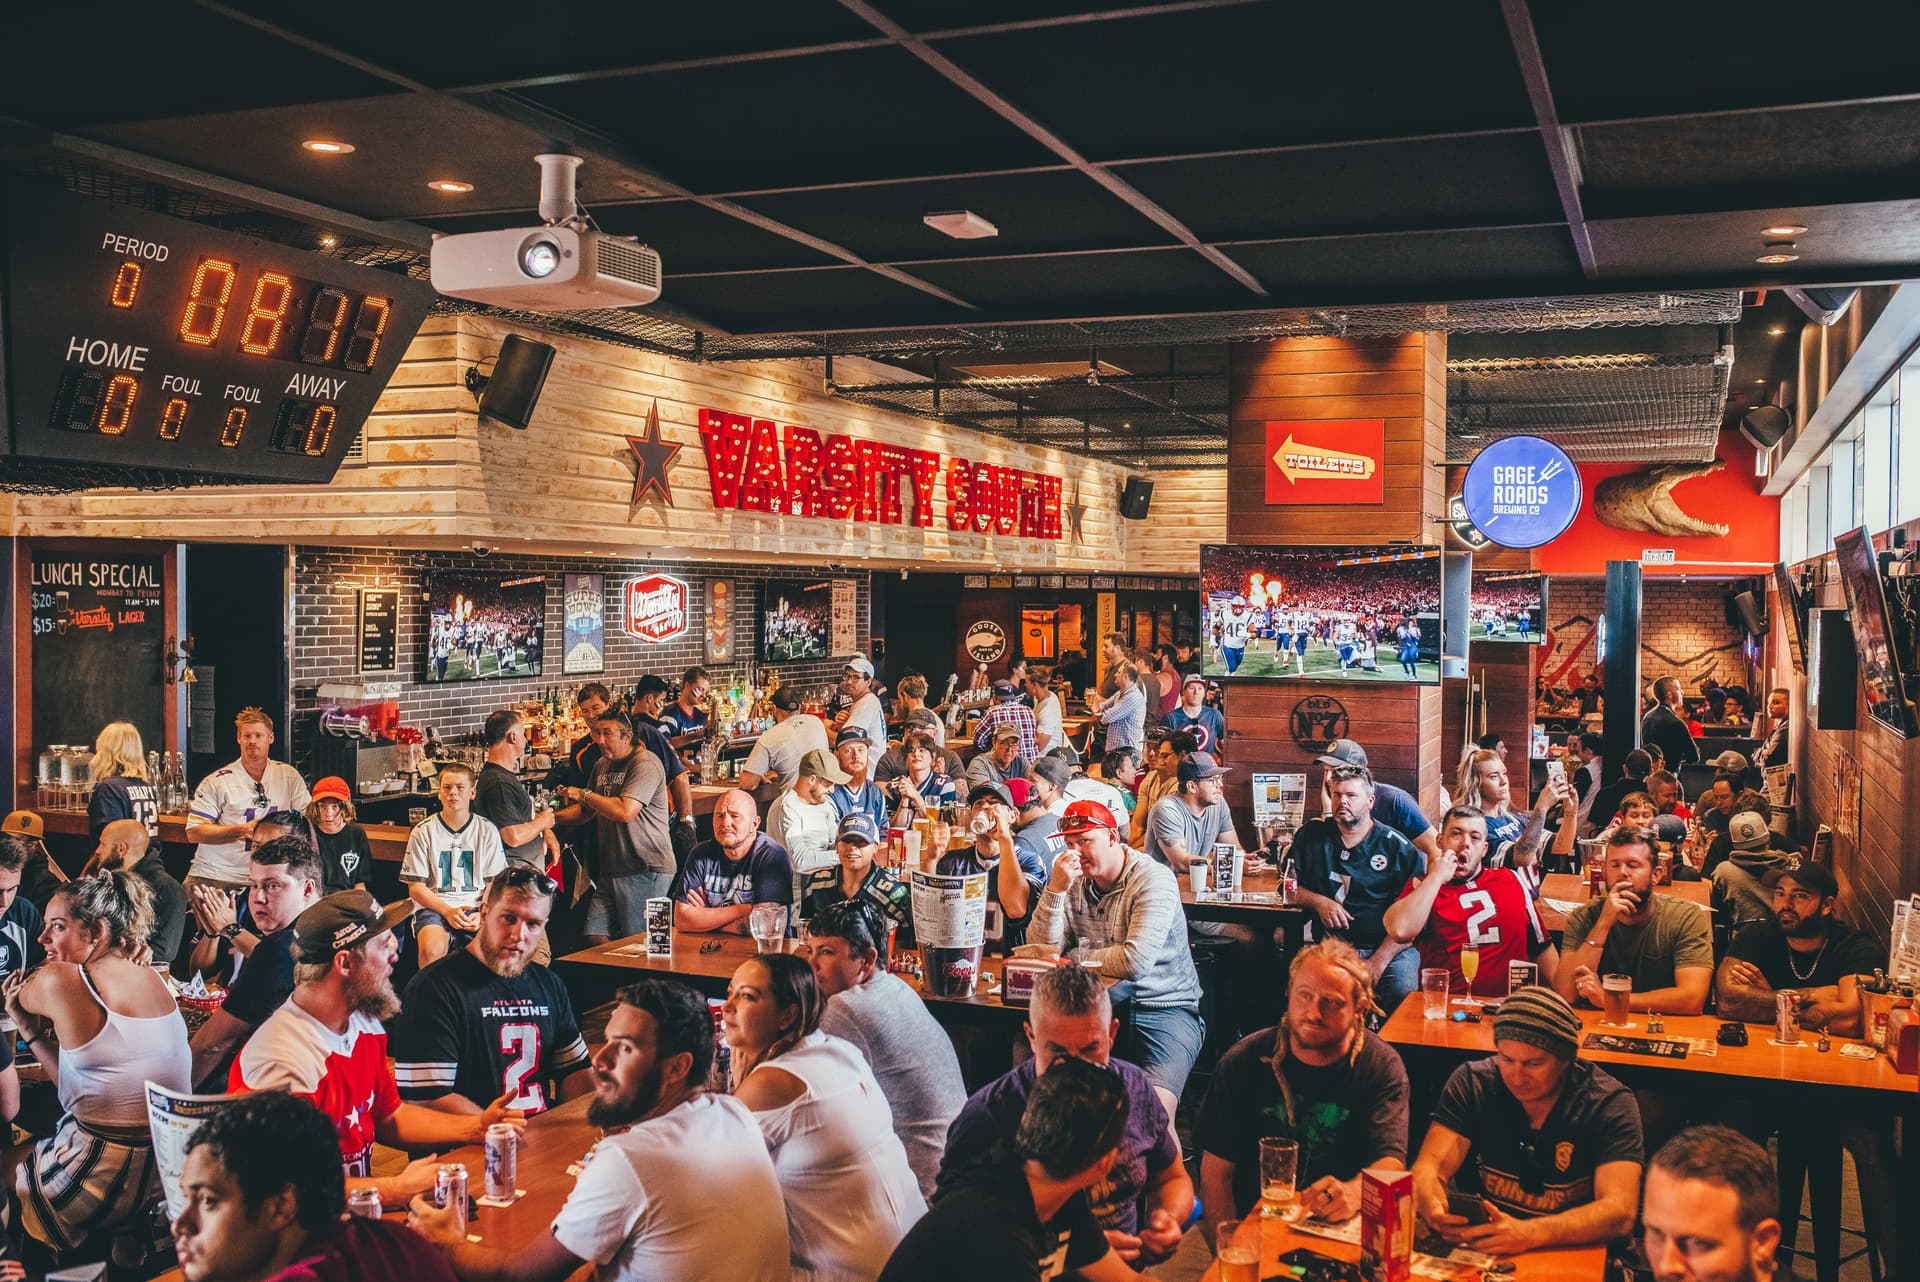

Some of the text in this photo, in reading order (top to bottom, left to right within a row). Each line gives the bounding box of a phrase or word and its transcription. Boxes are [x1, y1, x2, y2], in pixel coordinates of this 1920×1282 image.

[102, 232, 169, 263] PERIOD
[112, 262, 142, 307] 0
[66, 336, 149, 372] HOME
[161, 374, 202, 396] FOUL
[223, 384, 262, 404] FOUL
[284, 372, 346, 401] AWAY
[99, 374, 137, 435] 0
[304, 404, 336, 456] 0
[698, 408, 1063, 540] VARSITY SOUTH
[1284, 453, 1365, 474] TOILETS
[1493, 466, 1536, 485] GAGE
[1493, 485, 1549, 505] ROADS
[1493, 504, 1528, 515] BREWING
[31, 562, 160, 588] LUNCH SPECIAL
[565, 590, 603, 603] SUPER
[118, 611, 145, 624] LAGER
[568, 602, 601, 616] BOWL
[972, 623, 999, 633] GOOSE
[972, 648, 1001, 660] ISLAND
[133, 801, 159, 837] 12
[438, 850, 475, 894] 11
[1459, 890, 1500, 944] 2
[481, 1006, 549, 1018] FALCONS
[500, 1022, 547, 1116] 2
